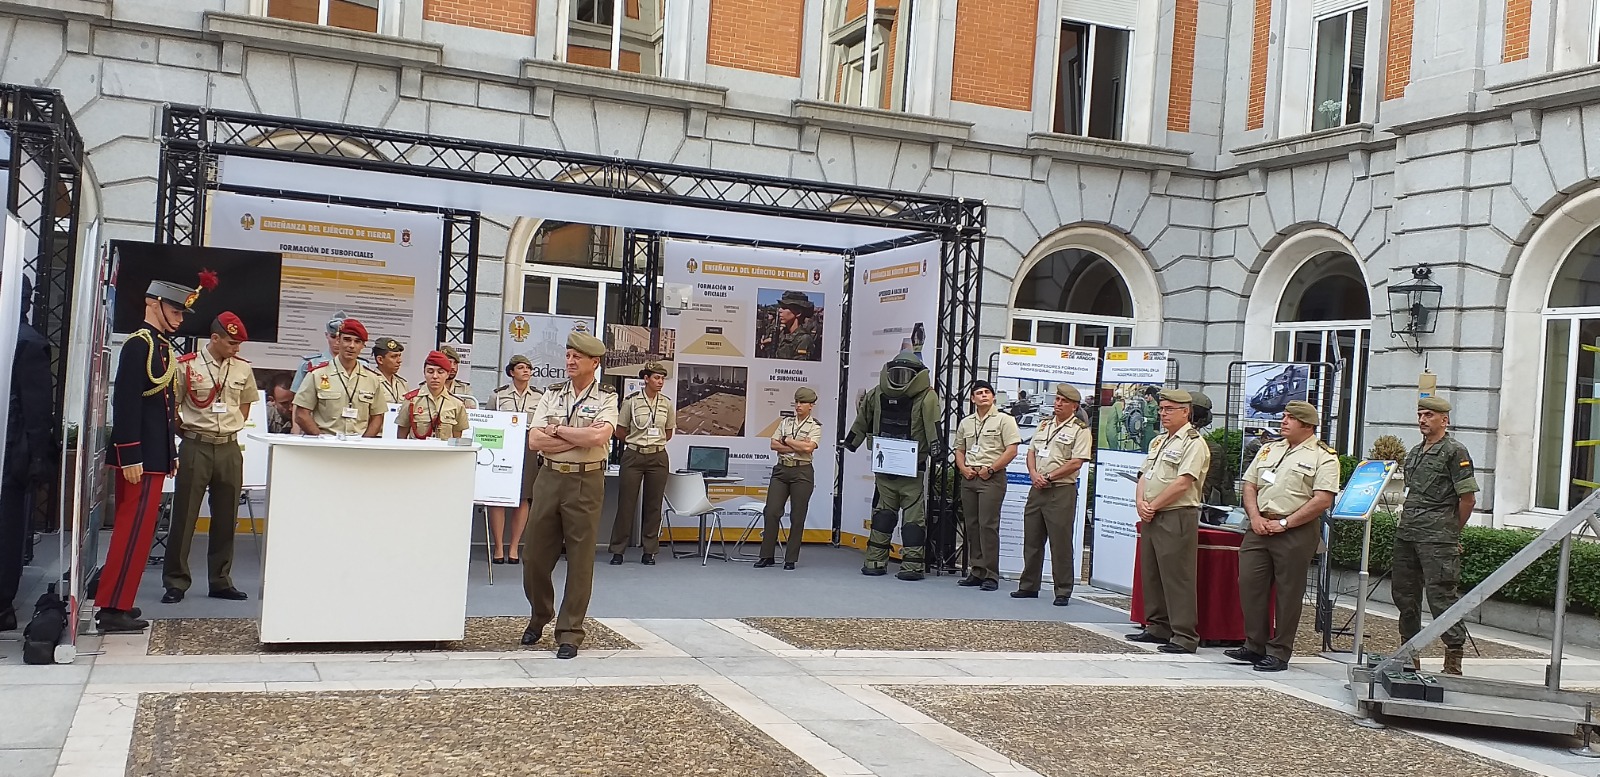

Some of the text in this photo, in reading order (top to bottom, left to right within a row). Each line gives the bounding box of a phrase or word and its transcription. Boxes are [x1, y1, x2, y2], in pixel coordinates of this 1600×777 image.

[264, 220, 306, 232] ENSEÑANZA
[323, 225, 354, 236] EJÉRCITO
[367, 231, 391, 240] TIERRA
[280, 244, 318, 253] FORMACIÓN
[331, 248, 374, 258] SUBOFICIALES
[704, 263, 738, 272] ENSEÑANZA
[752, 267, 775, 276] EJÉRCITO
[786, 270, 805, 279] TIERRA
